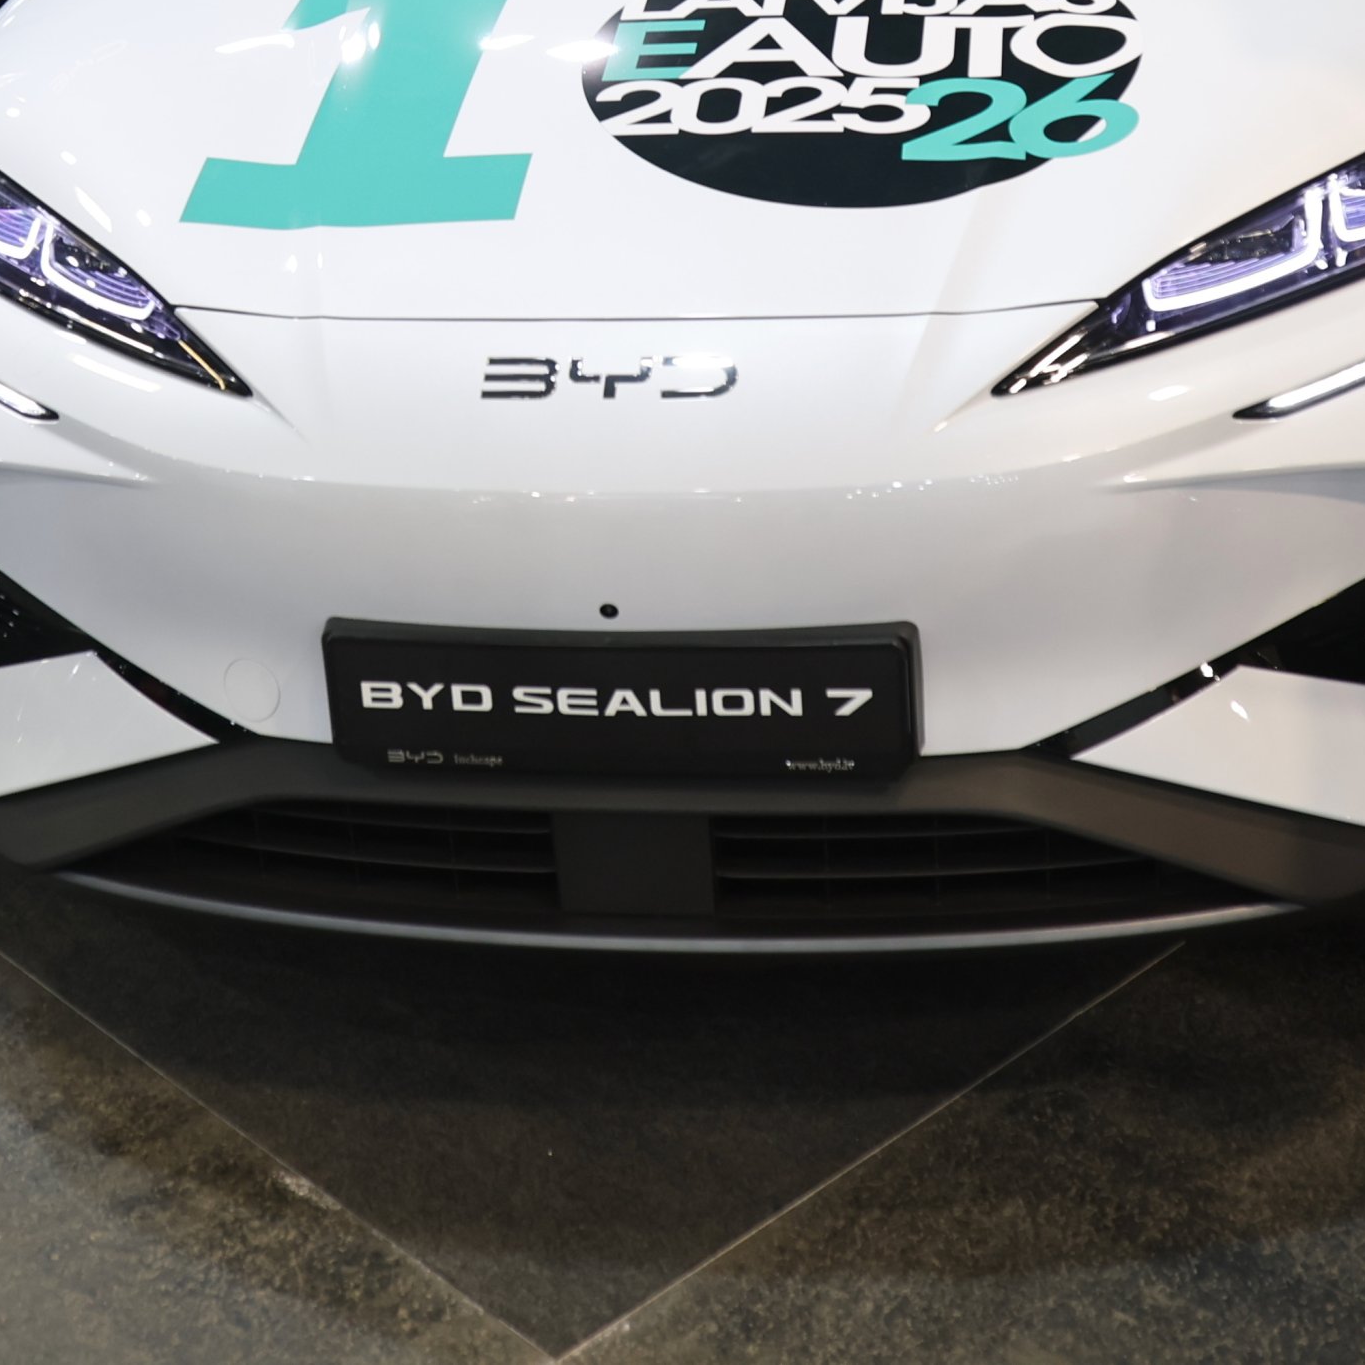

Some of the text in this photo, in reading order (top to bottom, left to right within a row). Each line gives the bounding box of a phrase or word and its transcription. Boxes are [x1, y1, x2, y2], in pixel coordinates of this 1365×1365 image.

[480, 352, 738, 402] BYD
[360, 680, 874, 718] BYD SEALION 7
